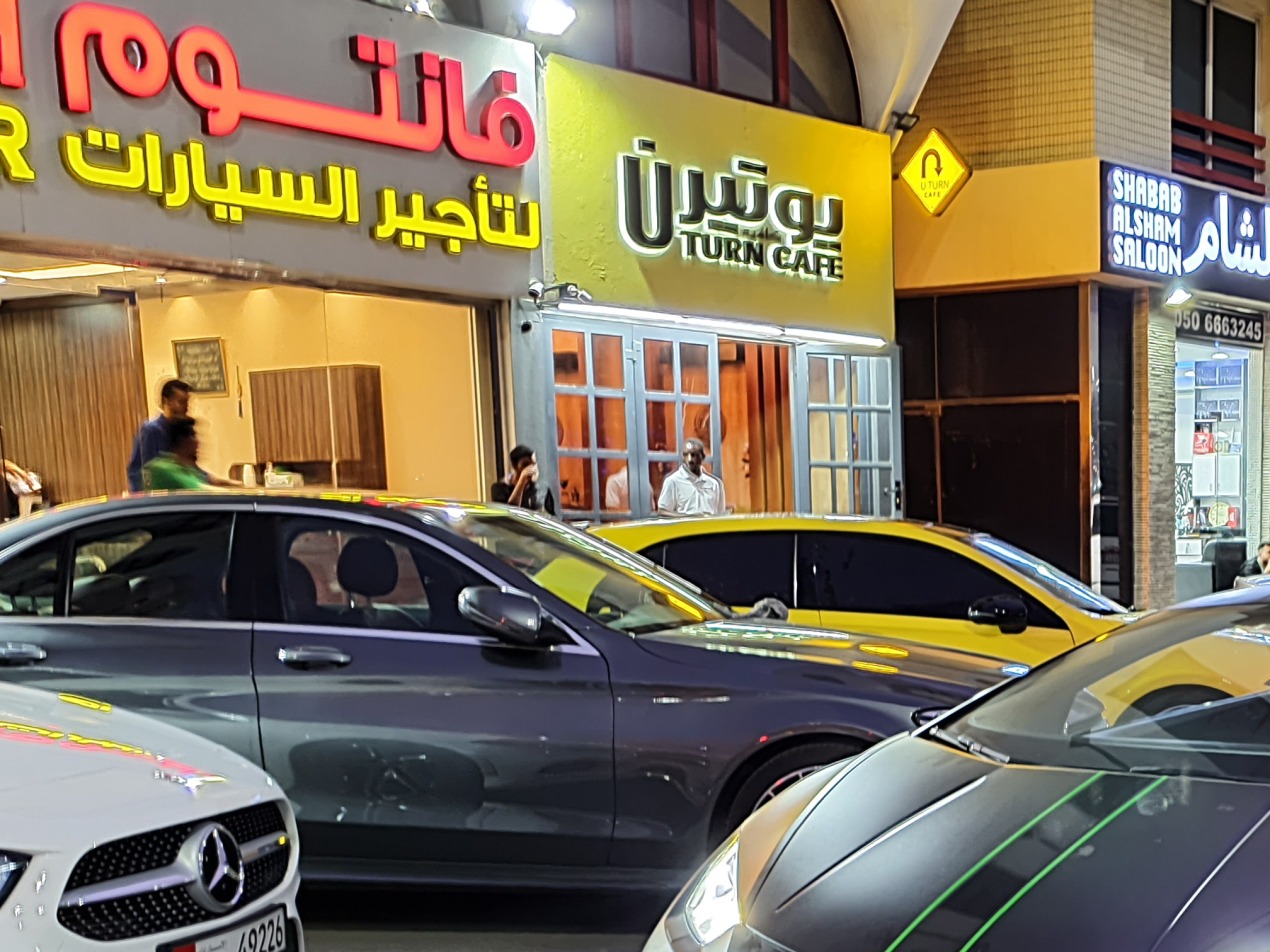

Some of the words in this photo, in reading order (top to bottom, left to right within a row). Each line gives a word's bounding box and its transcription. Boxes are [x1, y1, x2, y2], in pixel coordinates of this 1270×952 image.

[60, 128, 360, 224] السيارات
[920, 181, 927, 191] U
[928, 180, 950, 191] TURN
[1112, 168, 1182, 215] SHABAB
[374, 173, 541, 254] لتأجير
[1112, 203, 1181, 246] ALSHAM
[679, 230, 764, 269] TURN
[769, 244, 844, 282] CAFE
[1112, 233, 1182, 277] SALOON
[1175, 310, 1201, 331] 050
[1204, 313, 1262, 341] 6663245
